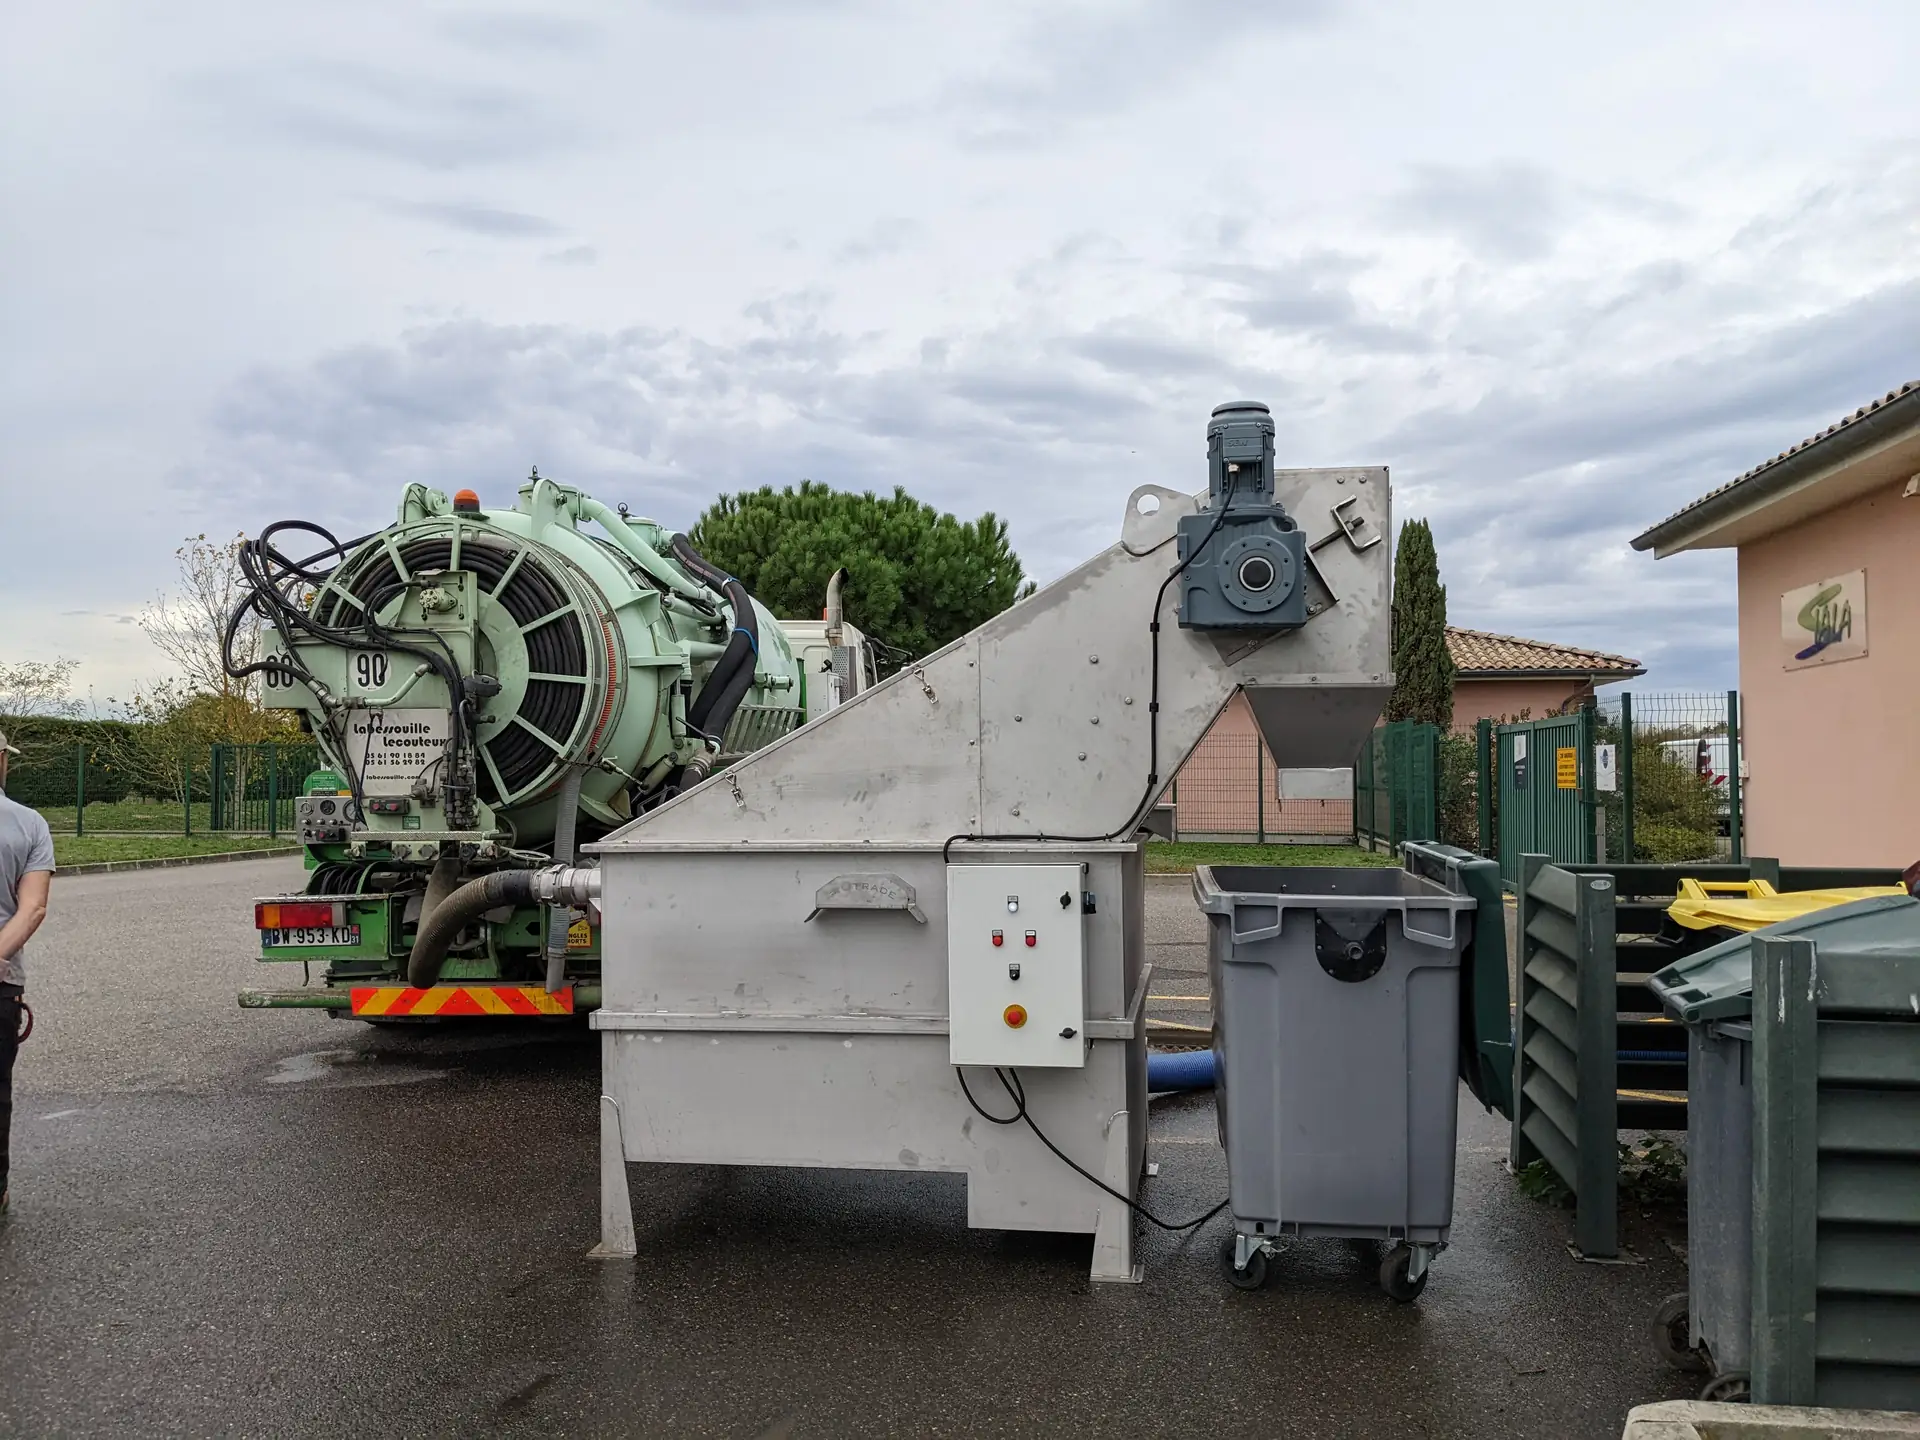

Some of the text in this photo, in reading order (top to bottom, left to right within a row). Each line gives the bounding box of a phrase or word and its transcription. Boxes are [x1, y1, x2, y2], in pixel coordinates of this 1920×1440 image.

[357, 653, 386, 687] 90
[272, 927, 350, 945] BW-953-KD
[351, 935, 359, 944] 31
